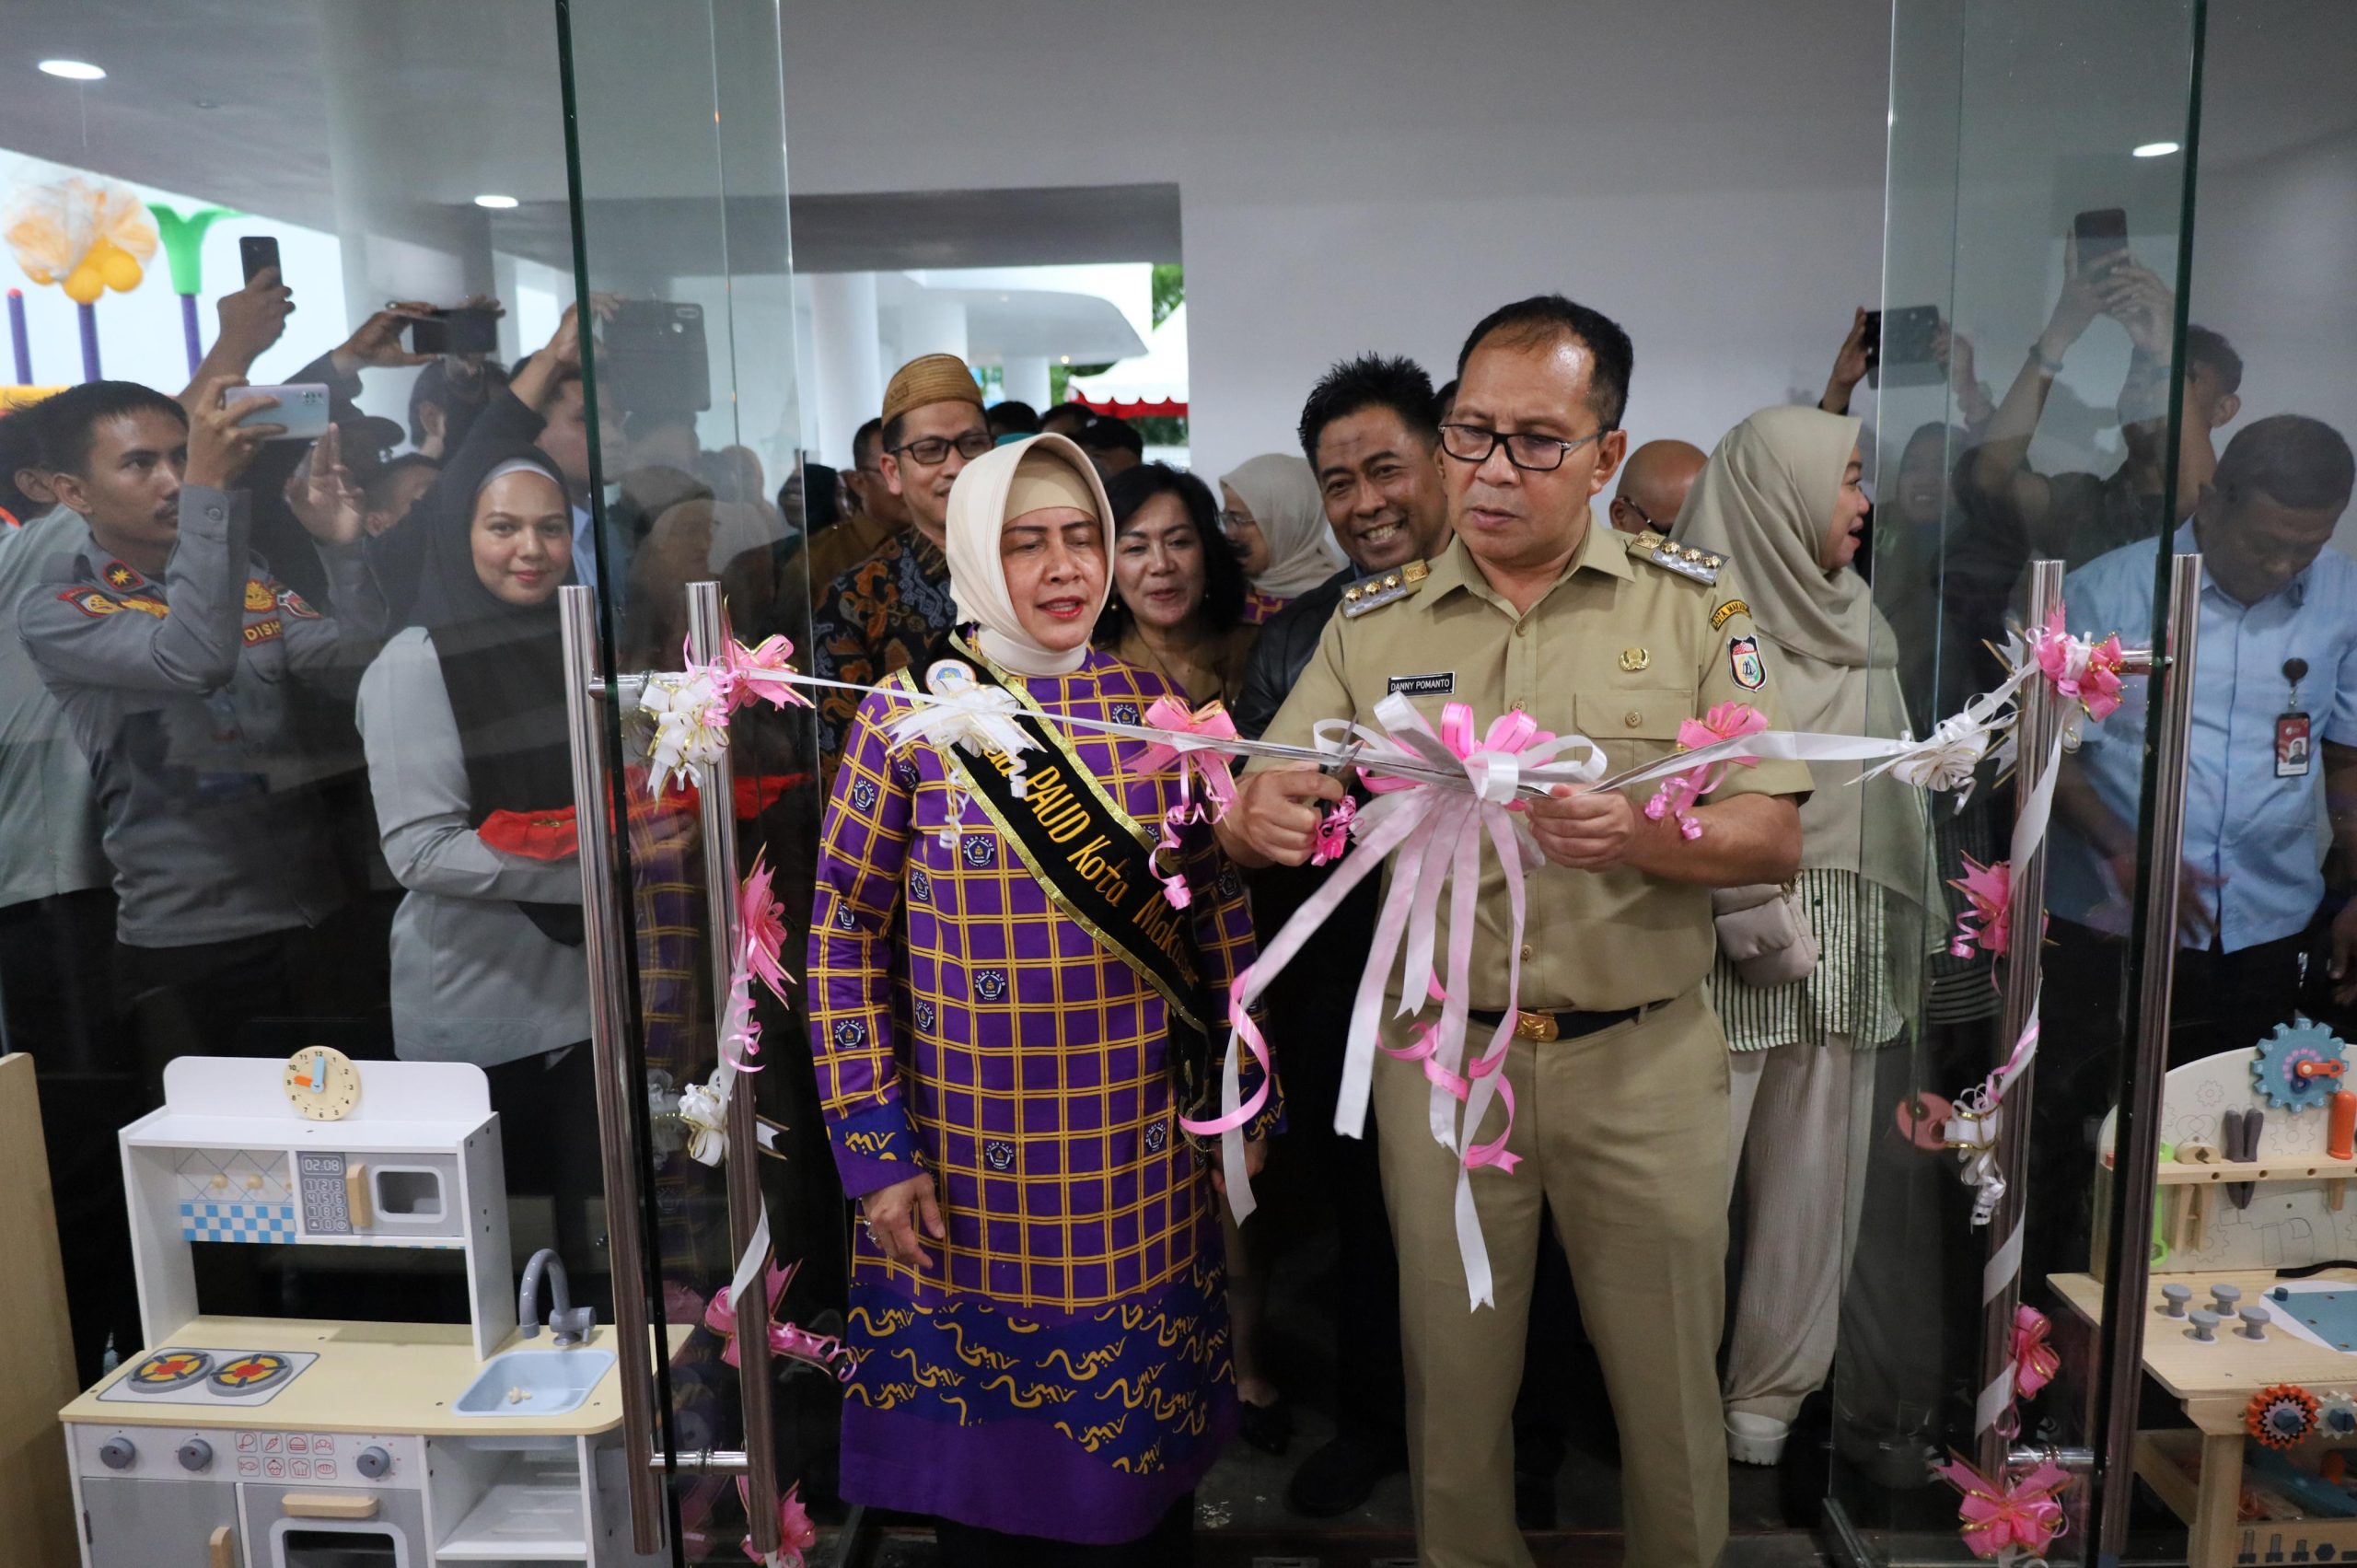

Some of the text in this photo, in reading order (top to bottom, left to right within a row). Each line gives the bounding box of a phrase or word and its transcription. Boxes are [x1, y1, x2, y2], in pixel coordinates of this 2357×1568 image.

[1390, 679, 1450, 691] DANNY POMANTO
[1024, 765, 1092, 843] PAUD
[1066, 834, 1132, 908] Kota
[304, 1158, 340, 1171] 02:08
[320, 1180, 328, 1191] 2
[334, 1180, 342, 1191] 3
[308, 1193, 343, 1203] 4 5 6
[309, 1206, 344, 1217] 7 8 9
[324, 1219, 332, 1230] 0
